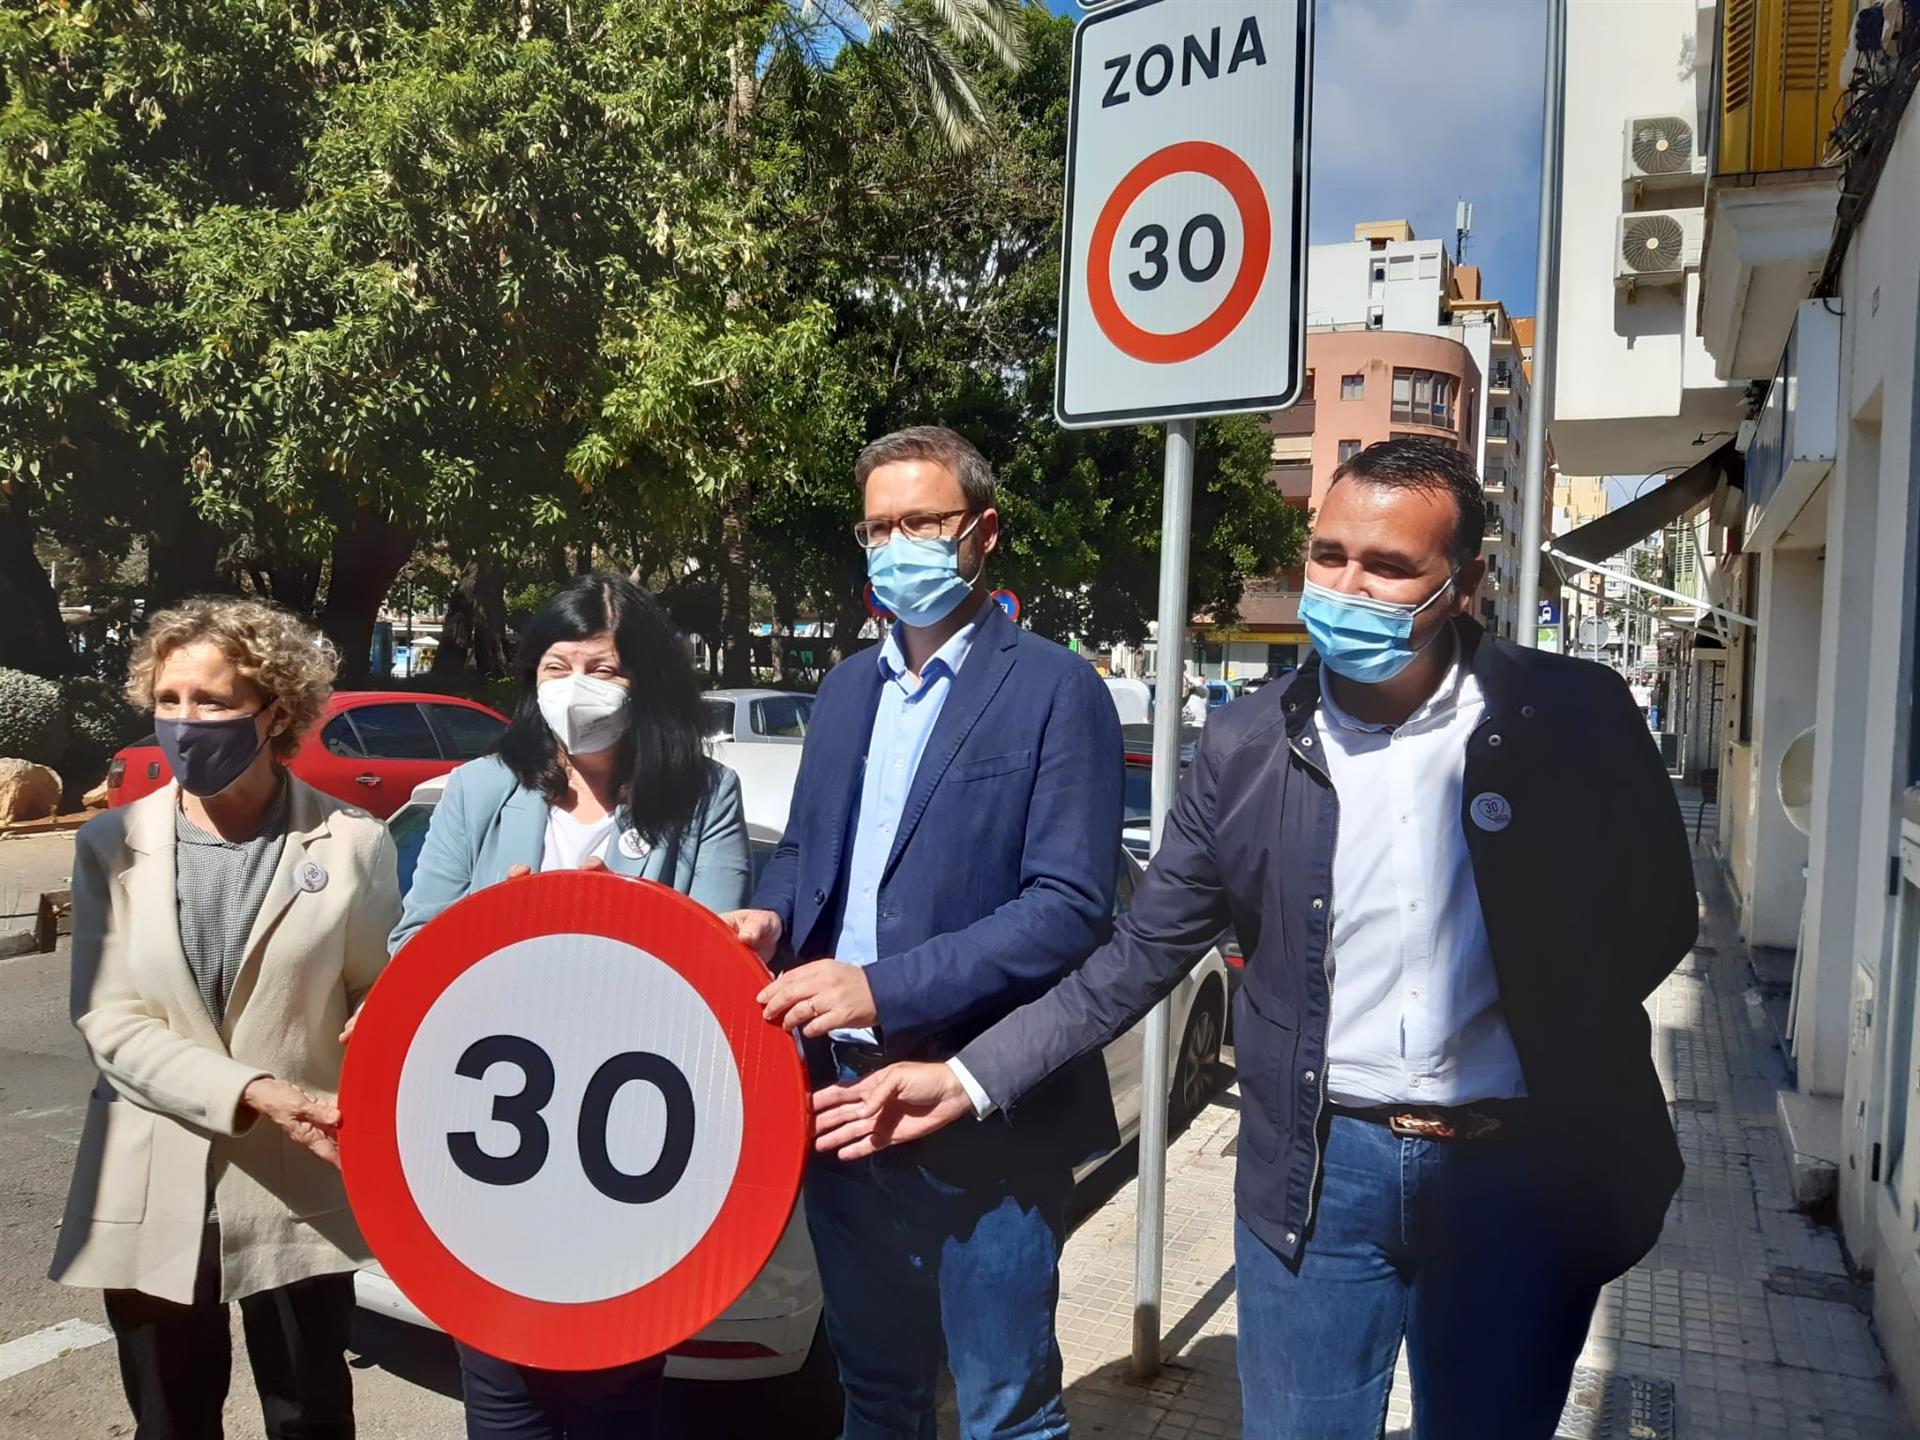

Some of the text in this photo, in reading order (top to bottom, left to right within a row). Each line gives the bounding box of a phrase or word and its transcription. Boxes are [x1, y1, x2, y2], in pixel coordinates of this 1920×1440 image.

[1102, 16, 1267, 108] ZONA
[1128, 213, 1226, 291] 30
[1485, 801, 1498, 814] 30
[446, 1034, 696, 1204] 30
